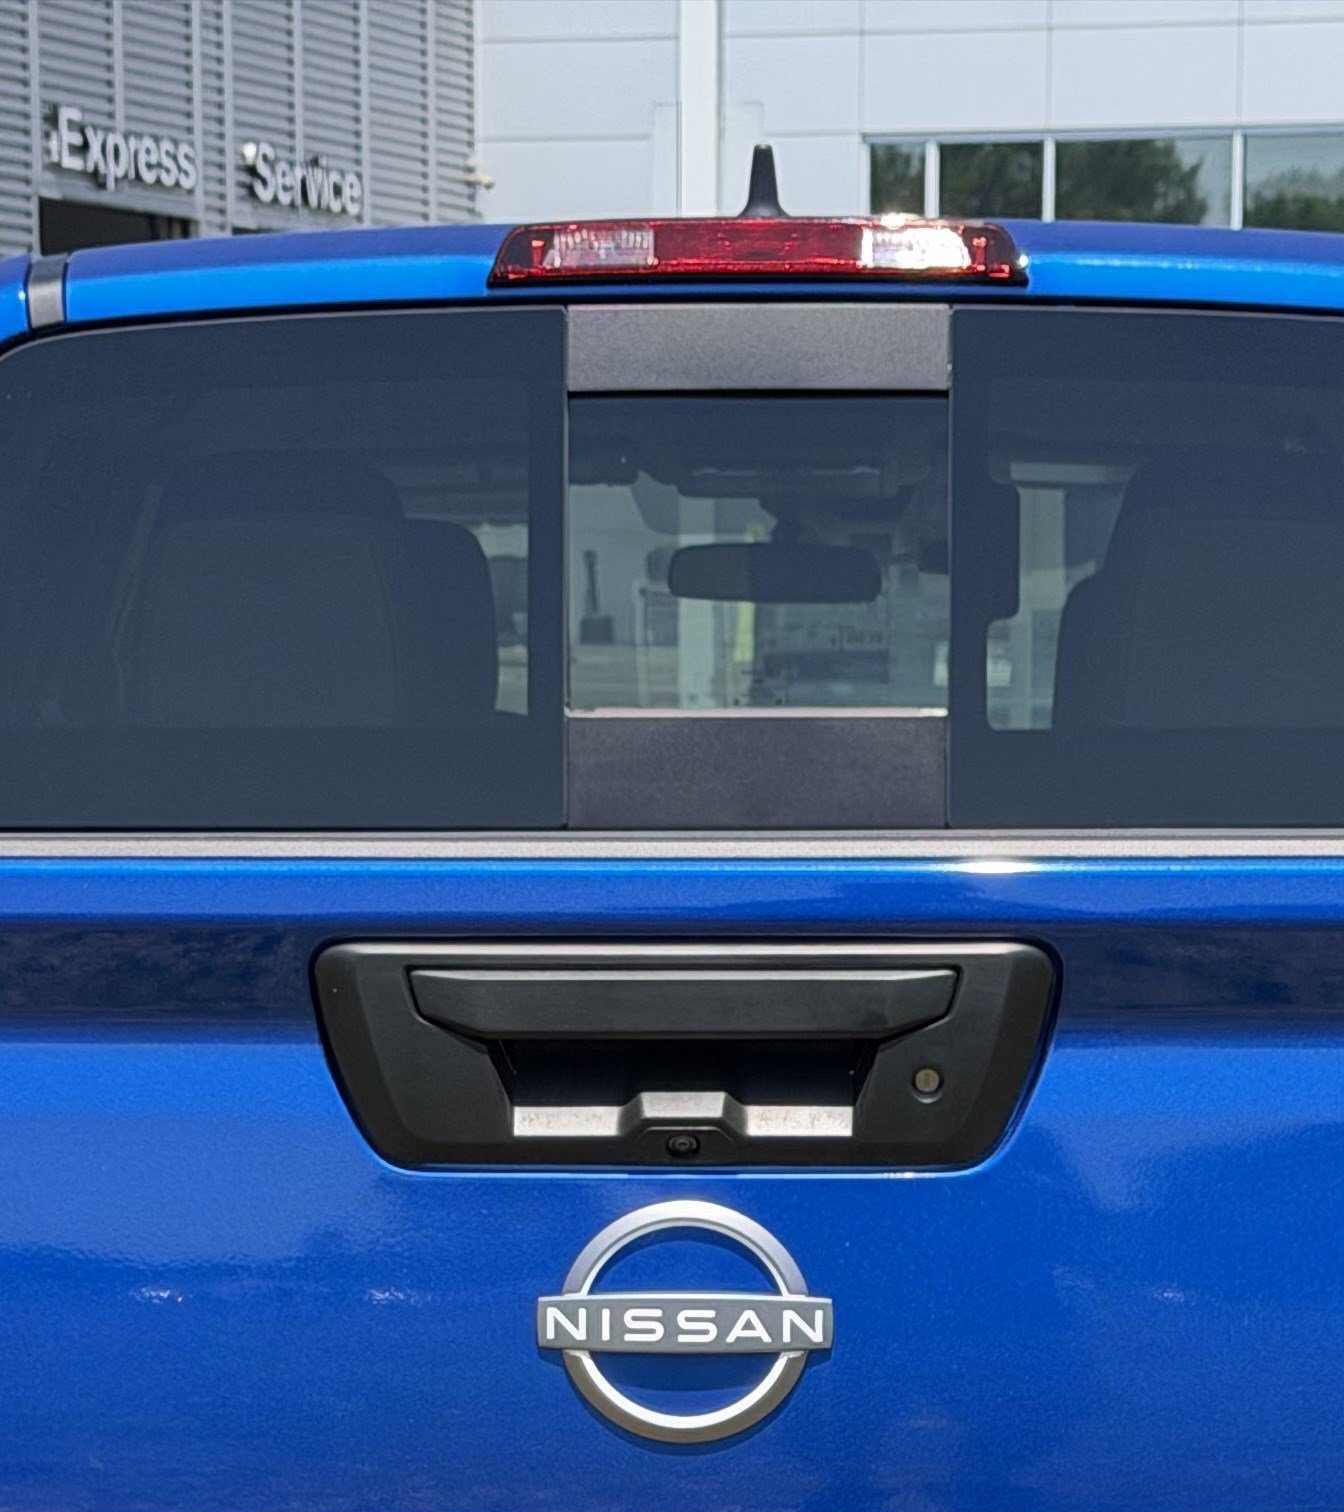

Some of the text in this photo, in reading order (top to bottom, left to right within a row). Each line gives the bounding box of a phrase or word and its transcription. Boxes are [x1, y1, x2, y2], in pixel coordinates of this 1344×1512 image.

[55, 105, 362, 216] Express Service
[546, 1306, 824, 1344] NISSAN
